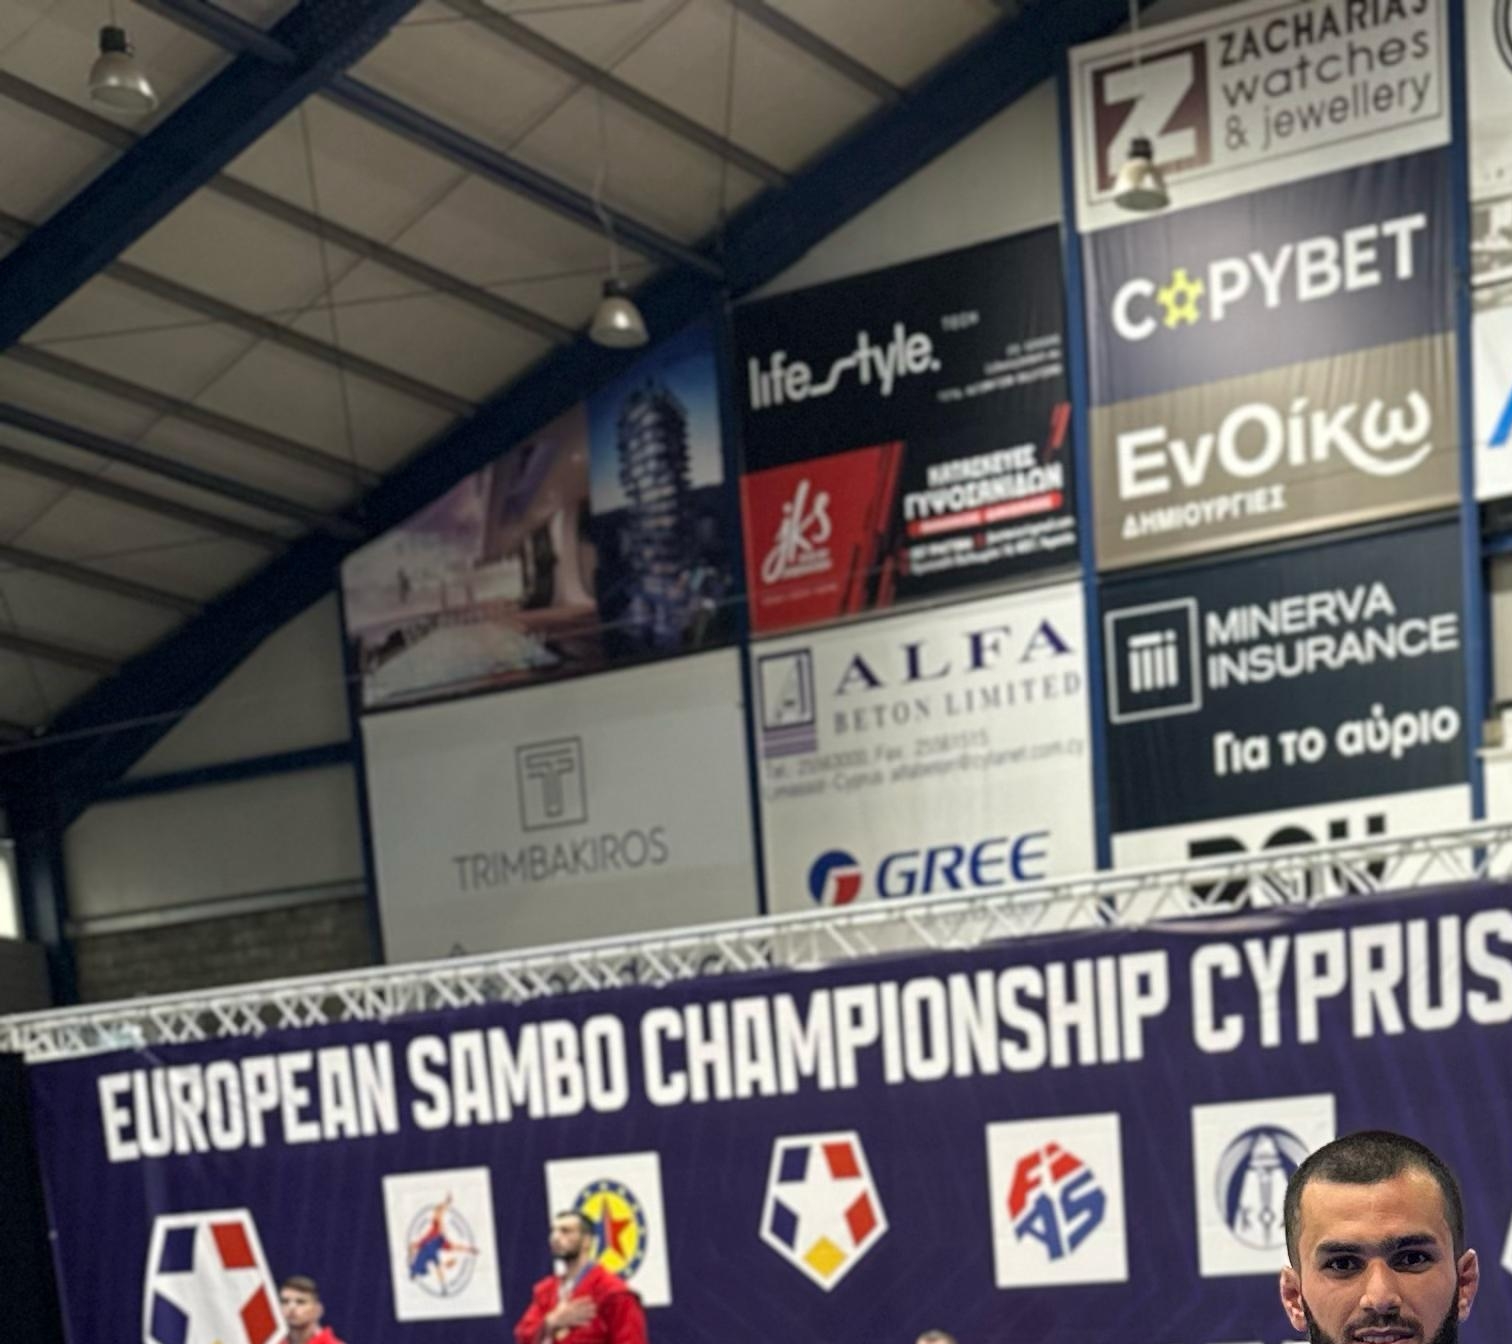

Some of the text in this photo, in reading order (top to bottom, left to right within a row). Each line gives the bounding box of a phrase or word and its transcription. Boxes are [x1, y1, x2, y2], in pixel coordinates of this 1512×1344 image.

[1222, 30, 1430, 108] watches
[1224, 72, 1432, 151] & jewellery
[1205, 581, 1396, 647] MINERVA
[1207, 612, 1460, 690] INSURANCE
[833, 618, 1074, 697] ALFA
[832, 671, 1083, 736] BETON LIMITED
[1213, 703, 1461, 776] Για το αύριο
[452, 826, 669, 892] TRIMBAKIROS
[875, 829, 1052, 900] GREE
[98, 1040, 400, 1163] EUROPEAN
[406, 1013, 629, 1130] SAMBO
[640, 950, 1170, 1106] CHAMPIONSHIP
